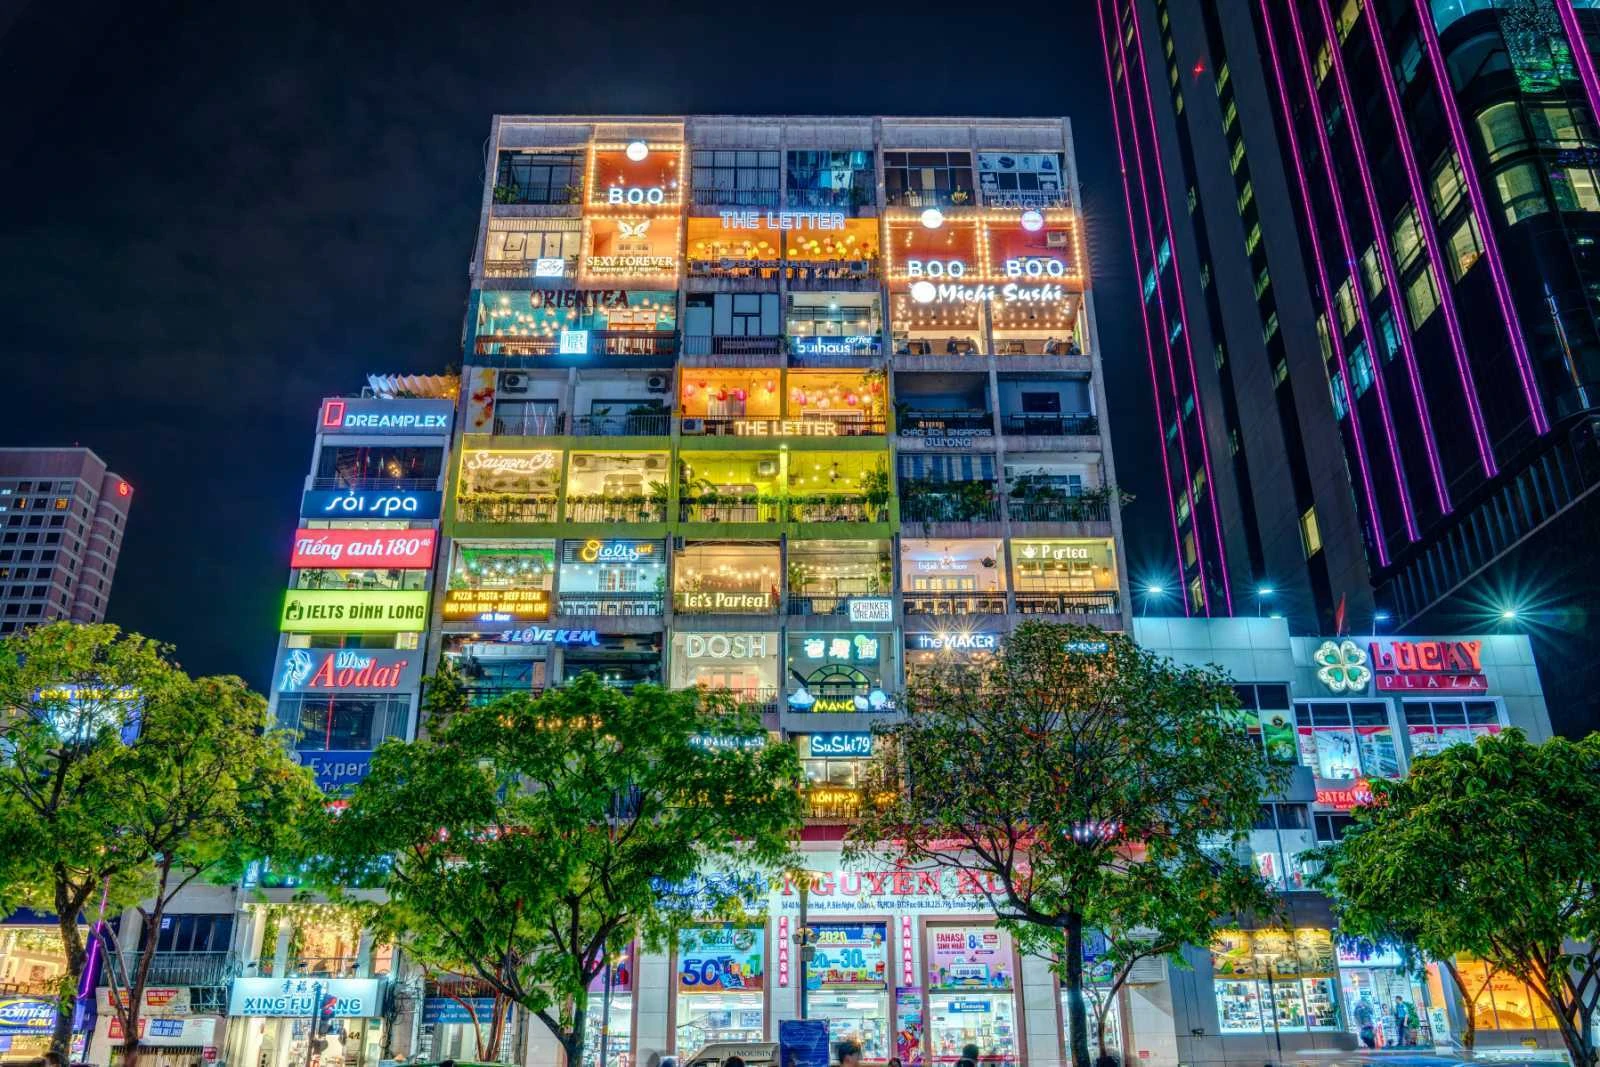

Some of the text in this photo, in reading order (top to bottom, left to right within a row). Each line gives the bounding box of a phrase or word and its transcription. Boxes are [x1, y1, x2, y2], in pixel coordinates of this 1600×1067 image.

[609, 188, 664, 204] BOO
[720, 211, 845, 230] THE LETTER
[587, 256, 673, 266] SEXY FOREVER
[908, 260, 964, 277] BOO
[1006, 259, 1064, 277] BOO
[530, 289, 628, 309] ORIENTEA
[939, 284, 1063, 302] Michi Sushi
[845, 335, 872, 344] coffee
[345, 415, 447, 427] DREAMPLEX
[735, 421, 837, 436] THE LETTER
[468, 450, 530, 475] Saigon
[370, 497, 417, 517] spa
[297, 536, 343, 559] Tiếng
[347, 541, 383, 555] anh
[454, 592, 472, 600] PIZZA
[478, 592, 498, 600] PASTA
[520, 592, 541, 600] STEAK
[685, 592, 769, 608] let's Partea!
[307, 605, 344, 618] IELTS
[388, 605, 424, 619] LONG
[512, 626, 556, 643] LOVE
[555, 629, 600, 646] KEM
[920, 635, 994, 649] the MAKER
[687, 635, 767, 658] DOSH
[337, 651, 370, 668] Miss
[1369, 641, 1482, 672] LUCKY
[1384, 675, 1481, 688] PLAZA
[936, 933, 964, 942] FAHASA
[778, 915, 789, 987] FAHASA
[902, 916, 912, 985] FAHASA
[245, 998, 285, 1010] XING
[291, 998, 312, 1010] FU
